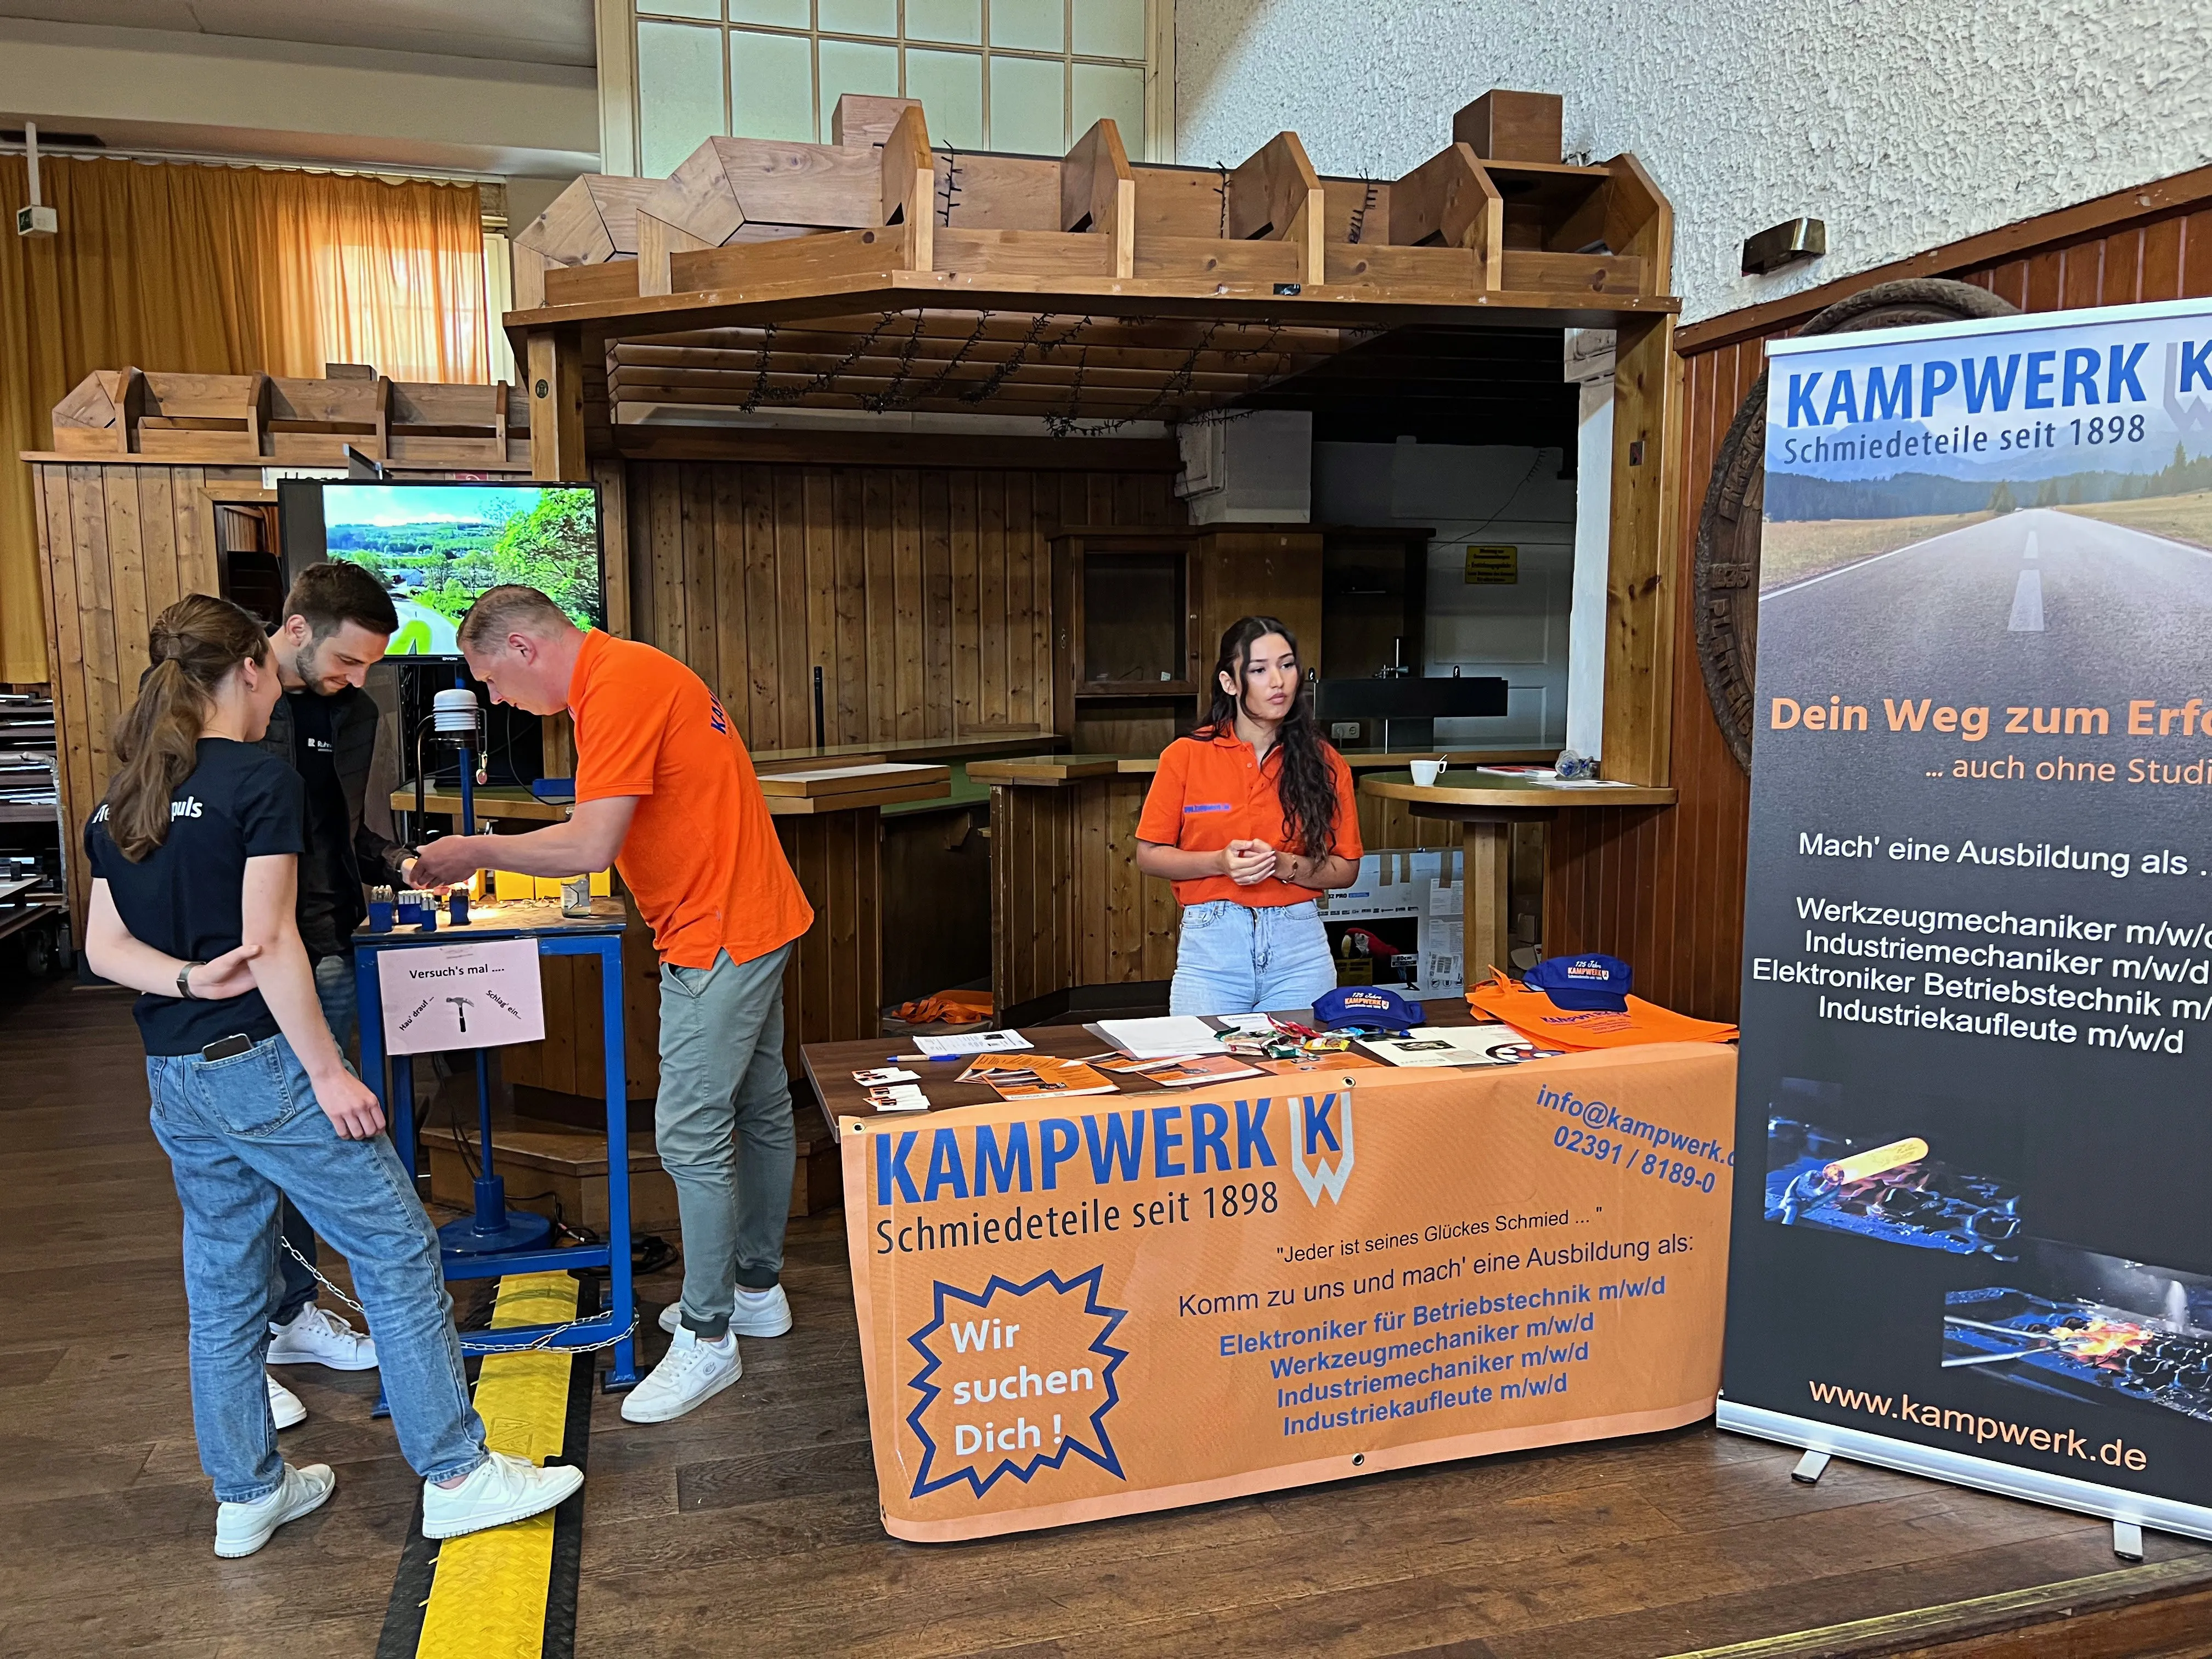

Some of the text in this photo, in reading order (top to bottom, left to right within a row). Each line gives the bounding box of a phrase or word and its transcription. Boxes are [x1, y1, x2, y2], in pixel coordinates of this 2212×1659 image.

[1788, 342, 2149, 428] KAMPWERK
[1784, 414, 2145, 465] Schmiedeteile seit 1898
[1771, 696, 1867, 731] Dein
[1884, 699, 1989, 741] Weg
[2005, 705, 2108, 735] zum
[1953, 755, 2024, 780] auch
[2036, 757, 2115, 782] ohne
[1799, 833, 1880, 860] Mach'
[1889, 839, 1949, 863] eine
[1957, 842, 2130, 878] Ausbildung
[2141, 851, 2188, 876] als
[1796, 897, 2116, 943] Werkzeugmechaniker
[409, 966, 464, 979] Versuch's
[467, 964, 488, 974] mal
[1805, 930, 2209, 985] Industriemechaniker m/w/d
[1753, 958, 1915, 994] Elektroniker
[1924, 973, 2161, 1017] Betriebstechnik
[1819, 996, 2184, 1055] Industriekaufleute m/w/d
[877, 1098, 1277, 1206] KAMPWERK
[1553, 1126, 1716, 1193] 02391 / 8189-0
[877, 1182, 1278, 1255] Schmiedeteile seit 1898
[1277, 1242, 1335, 1264] "Jeder
[1340, 1237, 1360, 1255] ist
[1365, 1230, 1419, 1253] seines
[1425, 1219, 1489, 1243] Glückes
[1495, 1210, 1570, 1232] Schmied
[1179, 1233, 1694, 1317] Komm zu uns und mach' eine Ausbildung als:
[950, 1319, 1020, 1354] Wir
[1220, 1276, 1666, 1357] Elektroniker für Betriebstechnik m/w/d
[1270, 1312, 1594, 1379] Werkzeugmechaniker m/w/d
[953, 1366, 1094, 1406] suchen
[1277, 1342, 1589, 1409] Industriemechaniker m/w/d
[1283, 1373, 1568, 1437] Industriekaufleute m/w/d
[955, 1417, 1041, 1456] Dich
[1809, 1380, 2148, 1471] www.kampwerk.de
